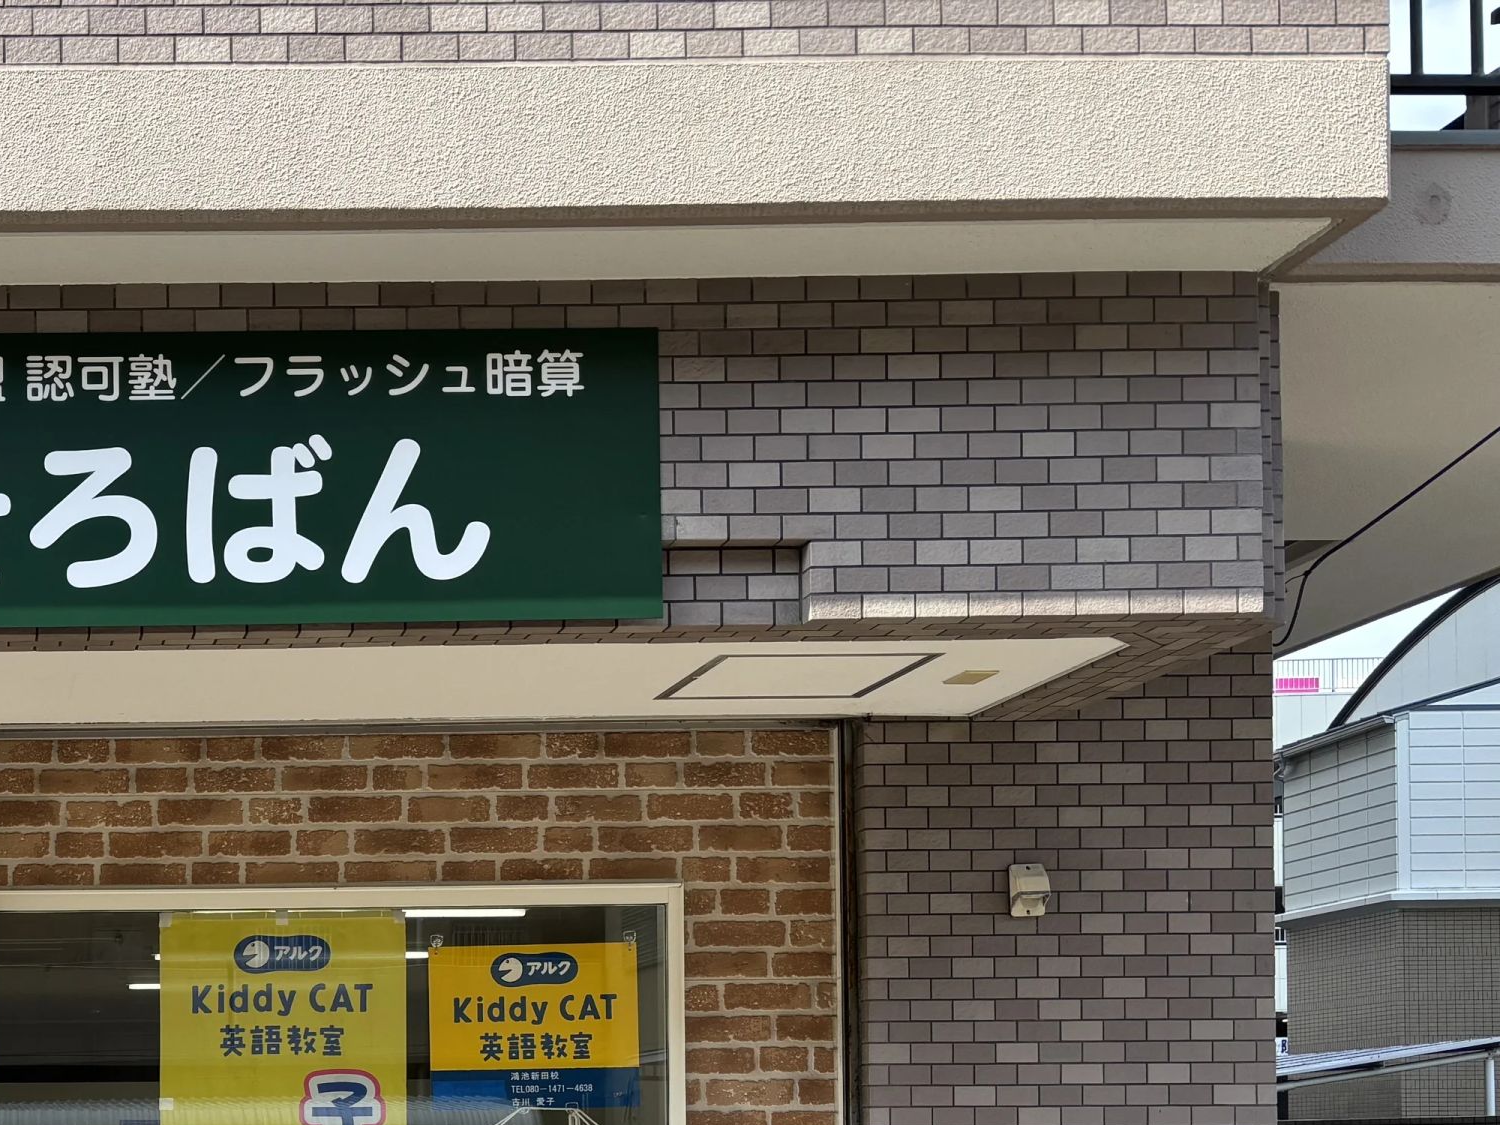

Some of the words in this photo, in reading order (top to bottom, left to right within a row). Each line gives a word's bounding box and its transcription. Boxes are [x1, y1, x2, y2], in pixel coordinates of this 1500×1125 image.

[274, 945, 323, 961] アルク
[527, 960, 571, 976] アルク
[192, 983, 296, 1016] Kiddy
[309, 982, 373, 1013] CAT
[453, 996, 548, 1025] Kiddy
[559, 993, 617, 1021] CAT
[220, 1024, 344, 1057] 英語教室
[479, 1032, 593, 1061] 英語教室
[510, 1071, 560, 1081] 鴻池新田校
